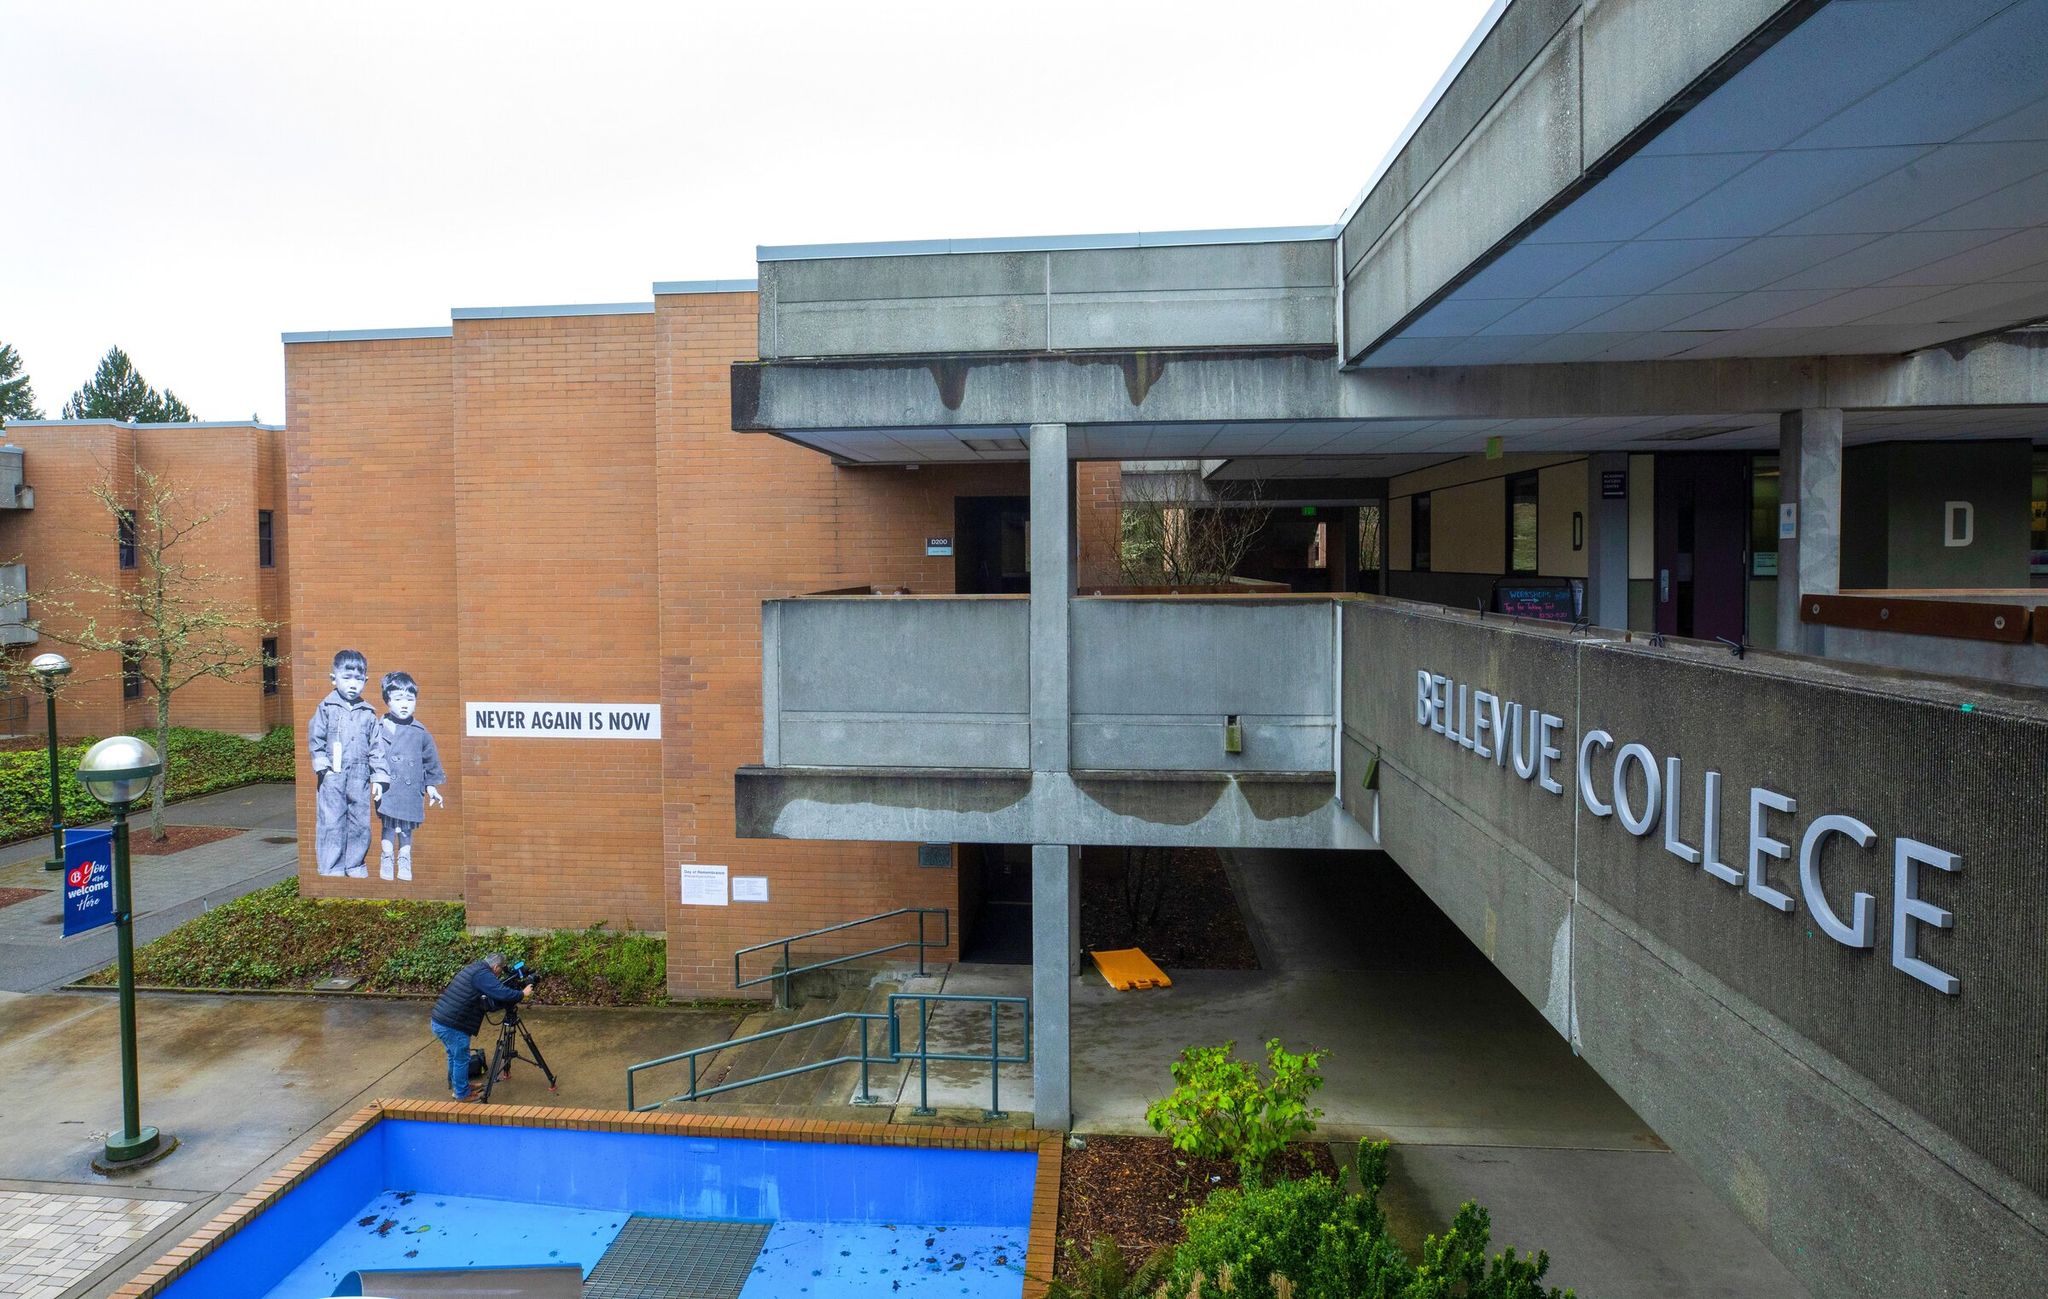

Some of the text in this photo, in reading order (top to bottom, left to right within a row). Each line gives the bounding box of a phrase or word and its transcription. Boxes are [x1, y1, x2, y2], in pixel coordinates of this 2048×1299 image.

[1573, 511, 1583, 551] D
[1944, 501, 1974, 547] D
[475, 710, 651, 731] NEVER AGAIN IS NOW
[1416, 669, 1963, 995] BELLEVUE COLLEGE
[82, 860, 109, 884] You
[67, 880, 109, 899] welcome
[76, 894, 101, 911] Here
